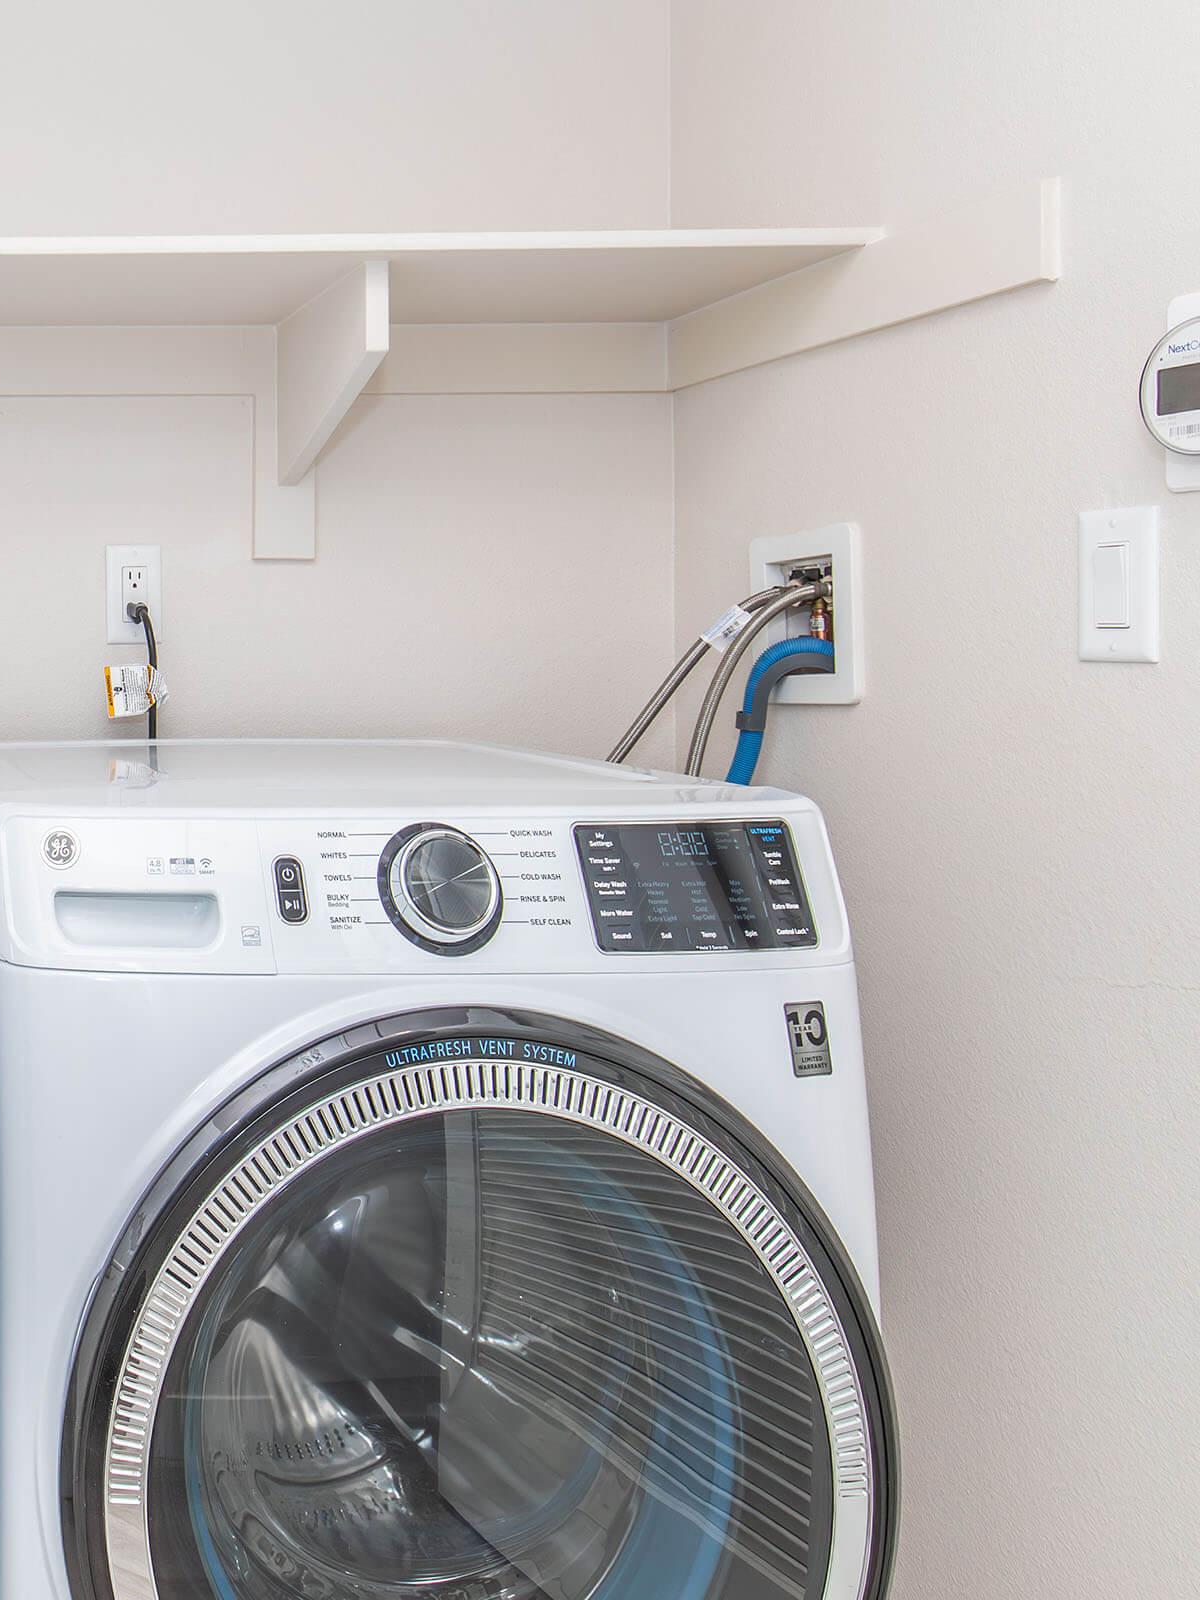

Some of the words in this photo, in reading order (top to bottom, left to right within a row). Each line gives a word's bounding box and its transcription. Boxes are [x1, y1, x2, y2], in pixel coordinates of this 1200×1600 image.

[1168, 340, 1200, 354] NextC
[786, 1009, 827, 1047] 10
[385, 1040, 472, 1068] ULTRAFRESH
[479, 1039, 516, 1056] VENT
[523, 1043, 577, 1067] SYSTEM
